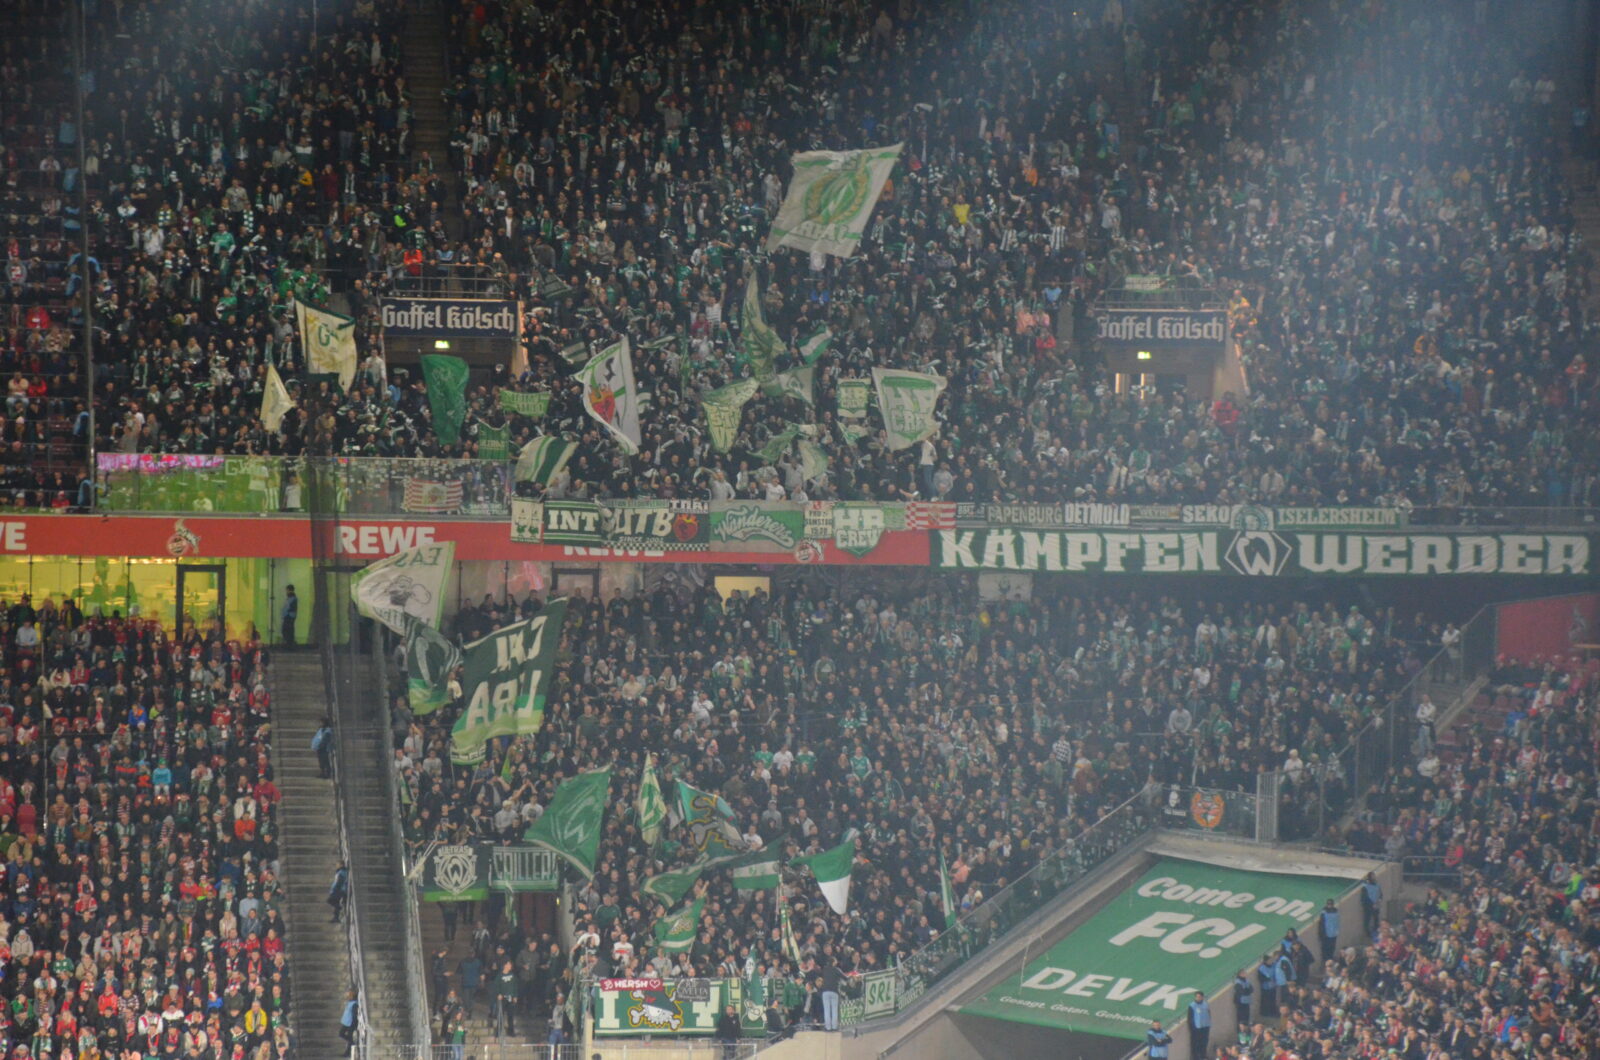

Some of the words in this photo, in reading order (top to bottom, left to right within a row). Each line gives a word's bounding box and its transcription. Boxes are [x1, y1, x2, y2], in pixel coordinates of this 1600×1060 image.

[382, 302, 444, 329] Gaffel
[446, 305, 514, 332] Kölsch
[1157, 315, 1224, 342] Kölsch
[548, 509, 599, 532] INT
[613, 508, 675, 537] UTB
[988, 506, 1063, 524] PAPENBURG
[1065, 503, 1130, 525] DETMOLD
[1278, 508, 1396, 525] ISELERSHEIM
[334, 526, 435, 554] REWE
[939, 528, 1221, 572] KÄMPFEN
[1297, 533, 1589, 574] WERDER
[1137, 876, 1255, 909] Come
[1254, 896, 1315, 922] on,
[1109, 911, 1267, 959] FC!
[614, 979, 649, 989] HERSH
[1021, 967, 1198, 1010] DEVK
